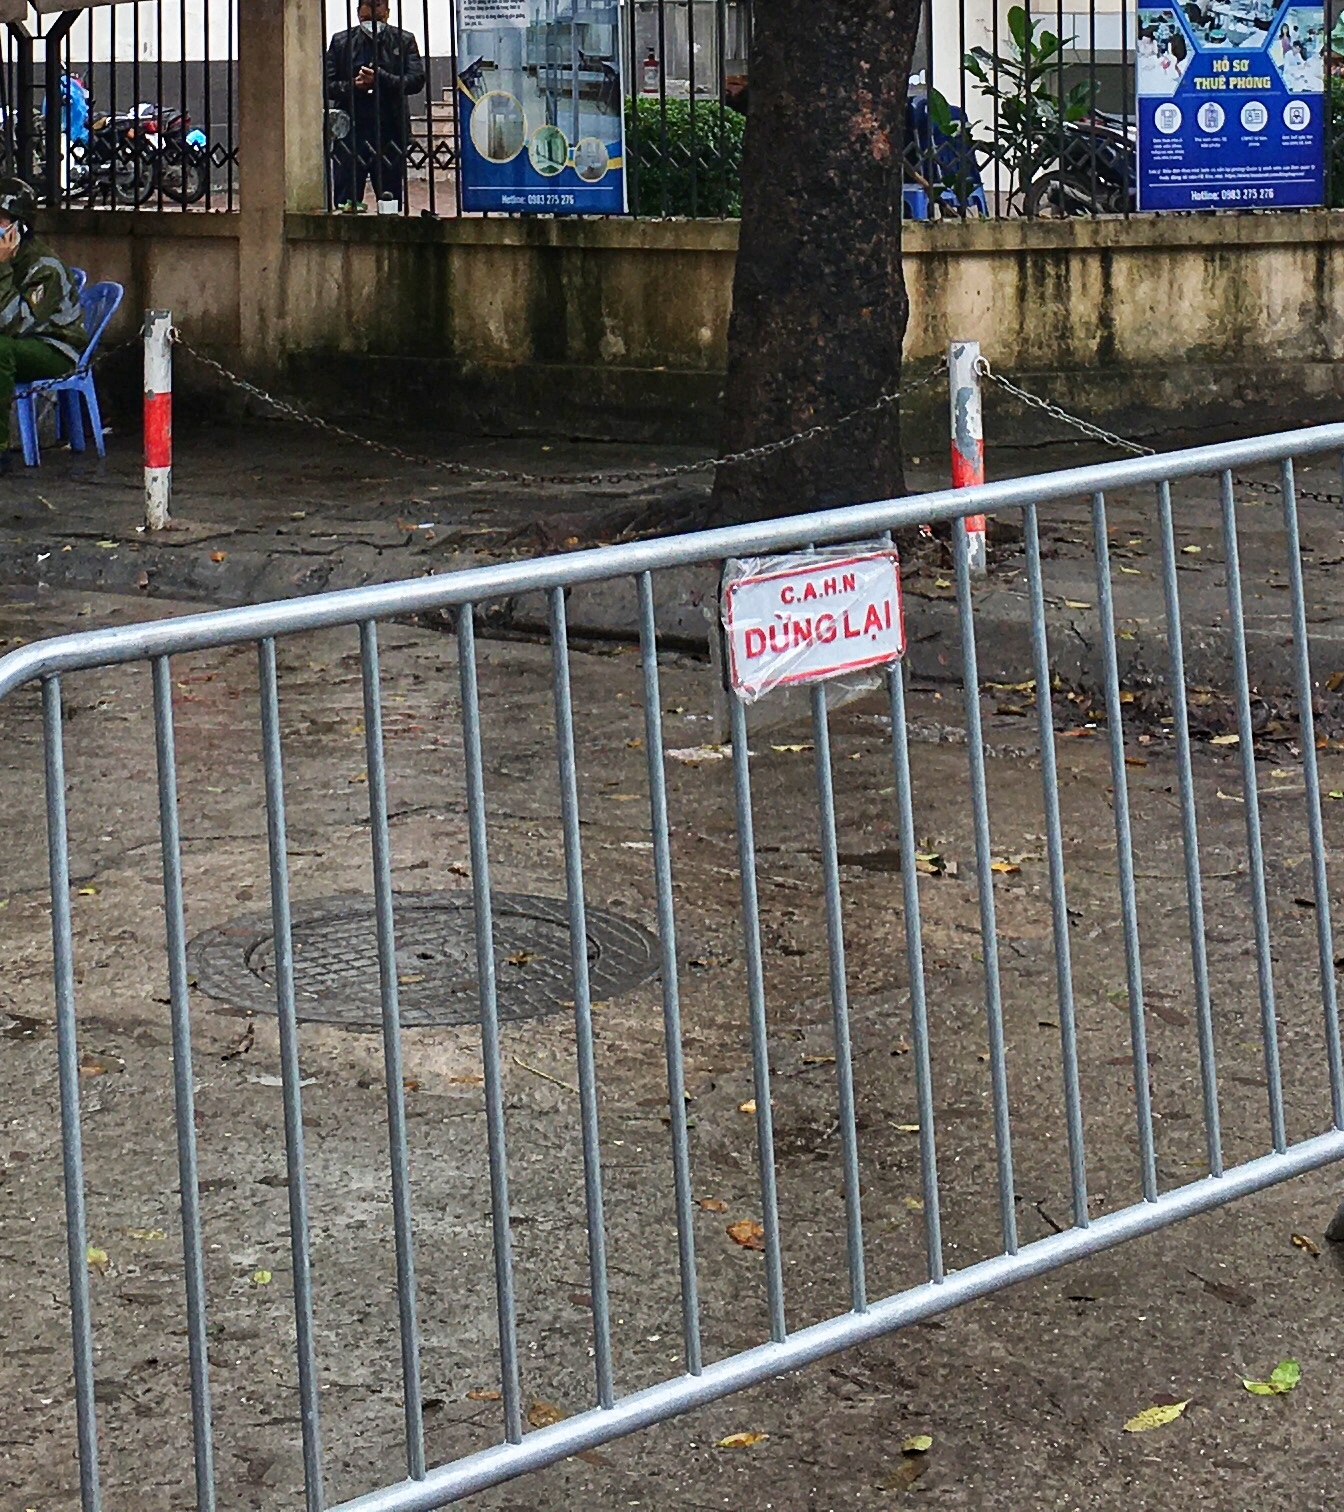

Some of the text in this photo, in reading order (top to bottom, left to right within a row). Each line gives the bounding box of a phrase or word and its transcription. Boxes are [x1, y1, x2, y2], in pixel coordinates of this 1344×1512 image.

[1194, 74, 1271, 90] THUÊ PHÒNG
[1242, 188, 1258, 200] 275
[781, 573, 856, 605] C.A.H.N
[744, 600, 892, 659] DỪNG LẠI
